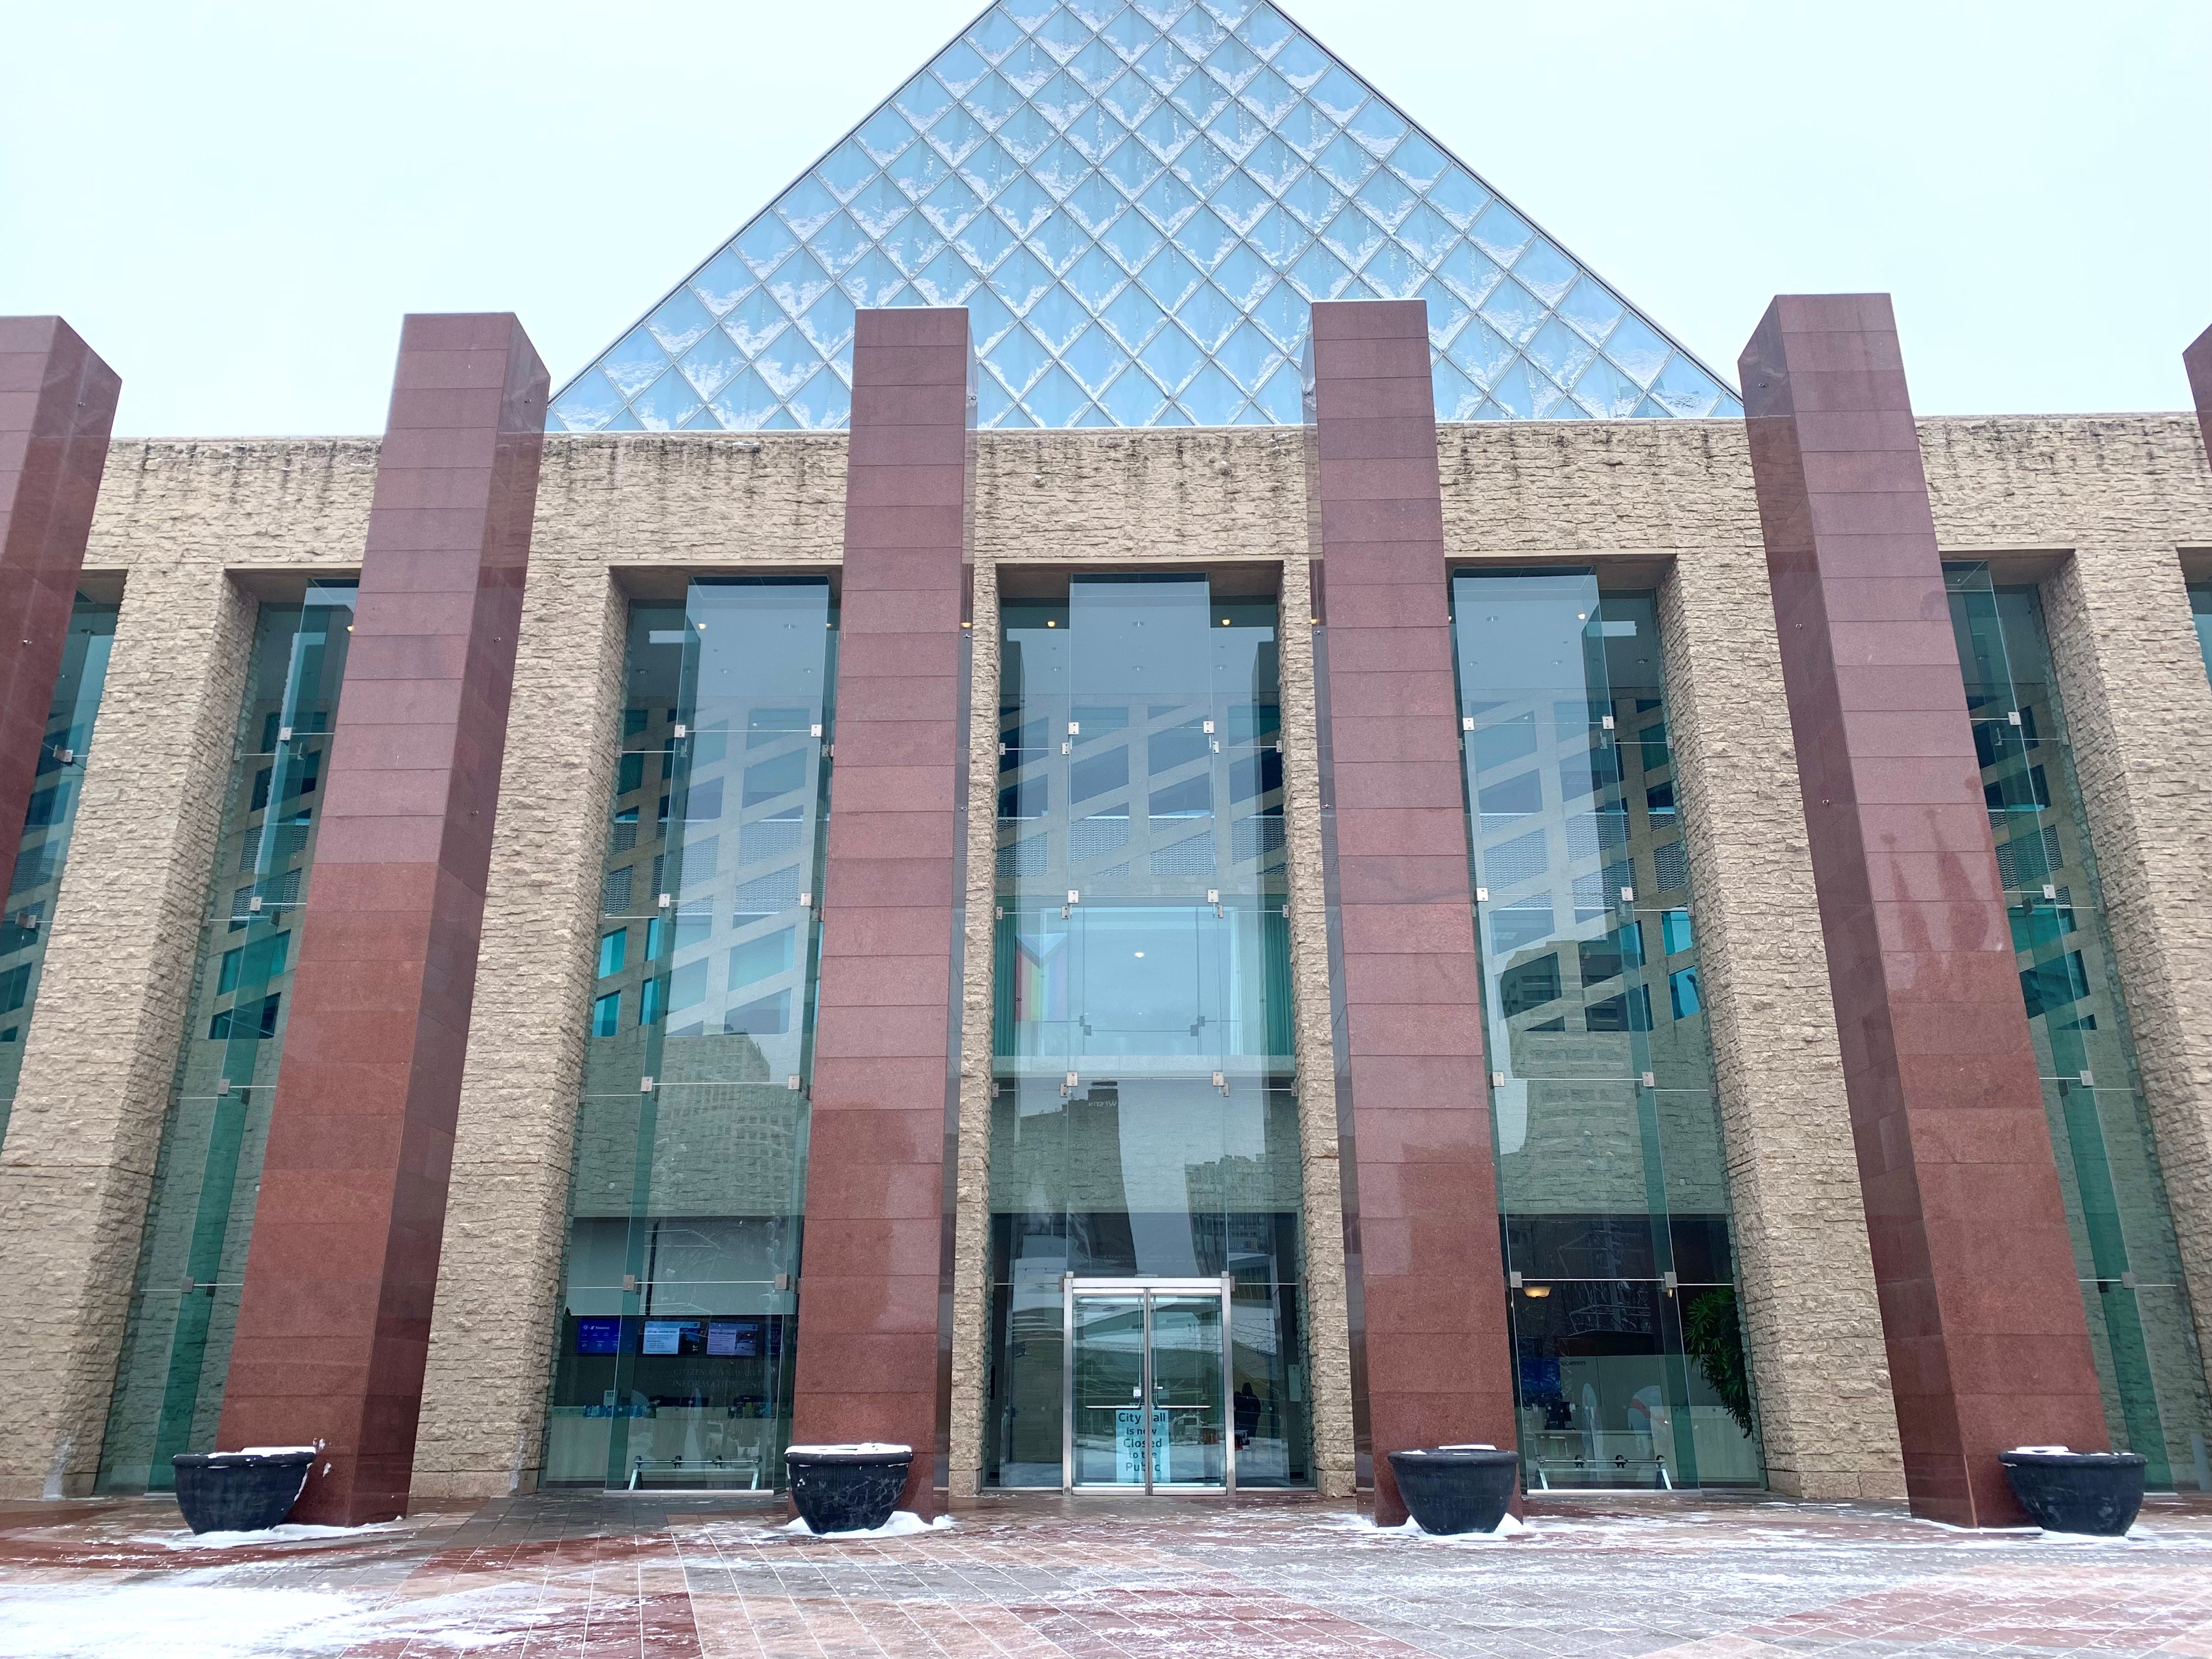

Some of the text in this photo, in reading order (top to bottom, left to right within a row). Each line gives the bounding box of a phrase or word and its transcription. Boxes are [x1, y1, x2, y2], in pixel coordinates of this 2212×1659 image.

[1118, 1412, 1166, 1425] City all
[1126, 1462, 1161, 1471] Pubc
